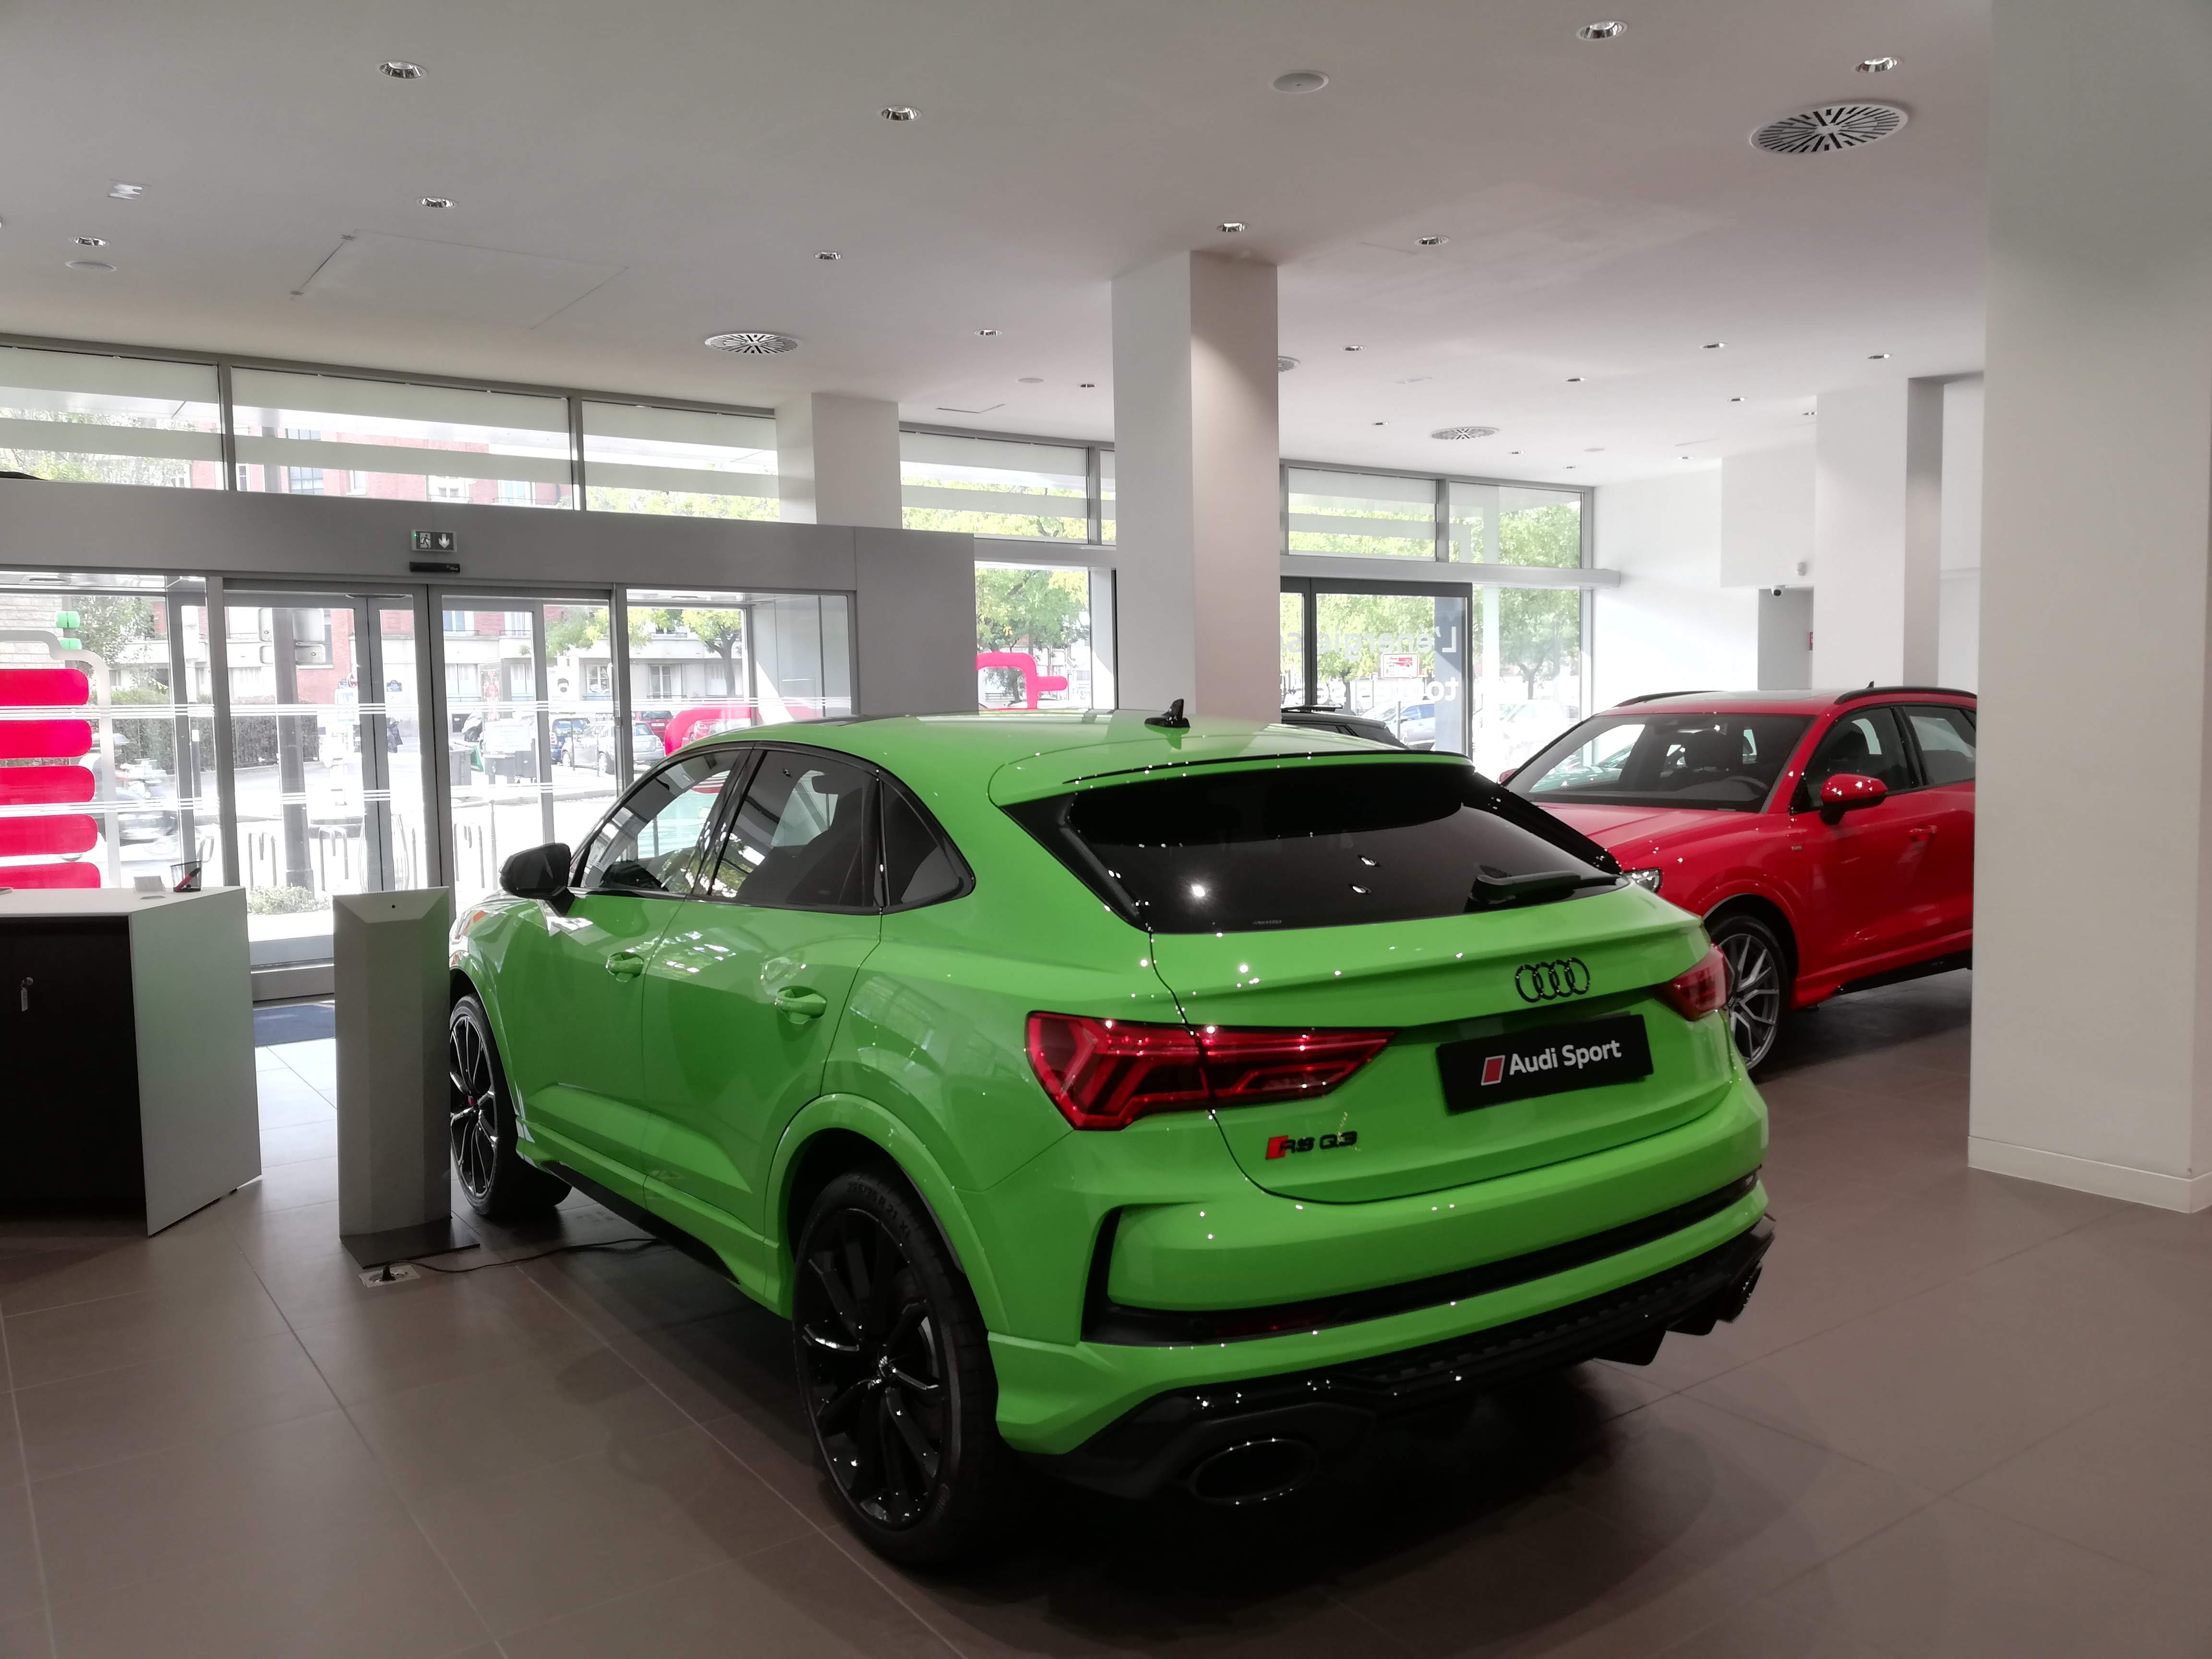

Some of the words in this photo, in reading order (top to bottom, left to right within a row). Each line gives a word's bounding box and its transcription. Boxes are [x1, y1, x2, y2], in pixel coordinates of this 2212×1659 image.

[1509, 1047, 1559, 1075] Audi
[1562, 1040, 1622, 1070] Sport
[1278, 1137, 1315, 1154] RS
[1320, 1130, 1358, 1149] Q3
